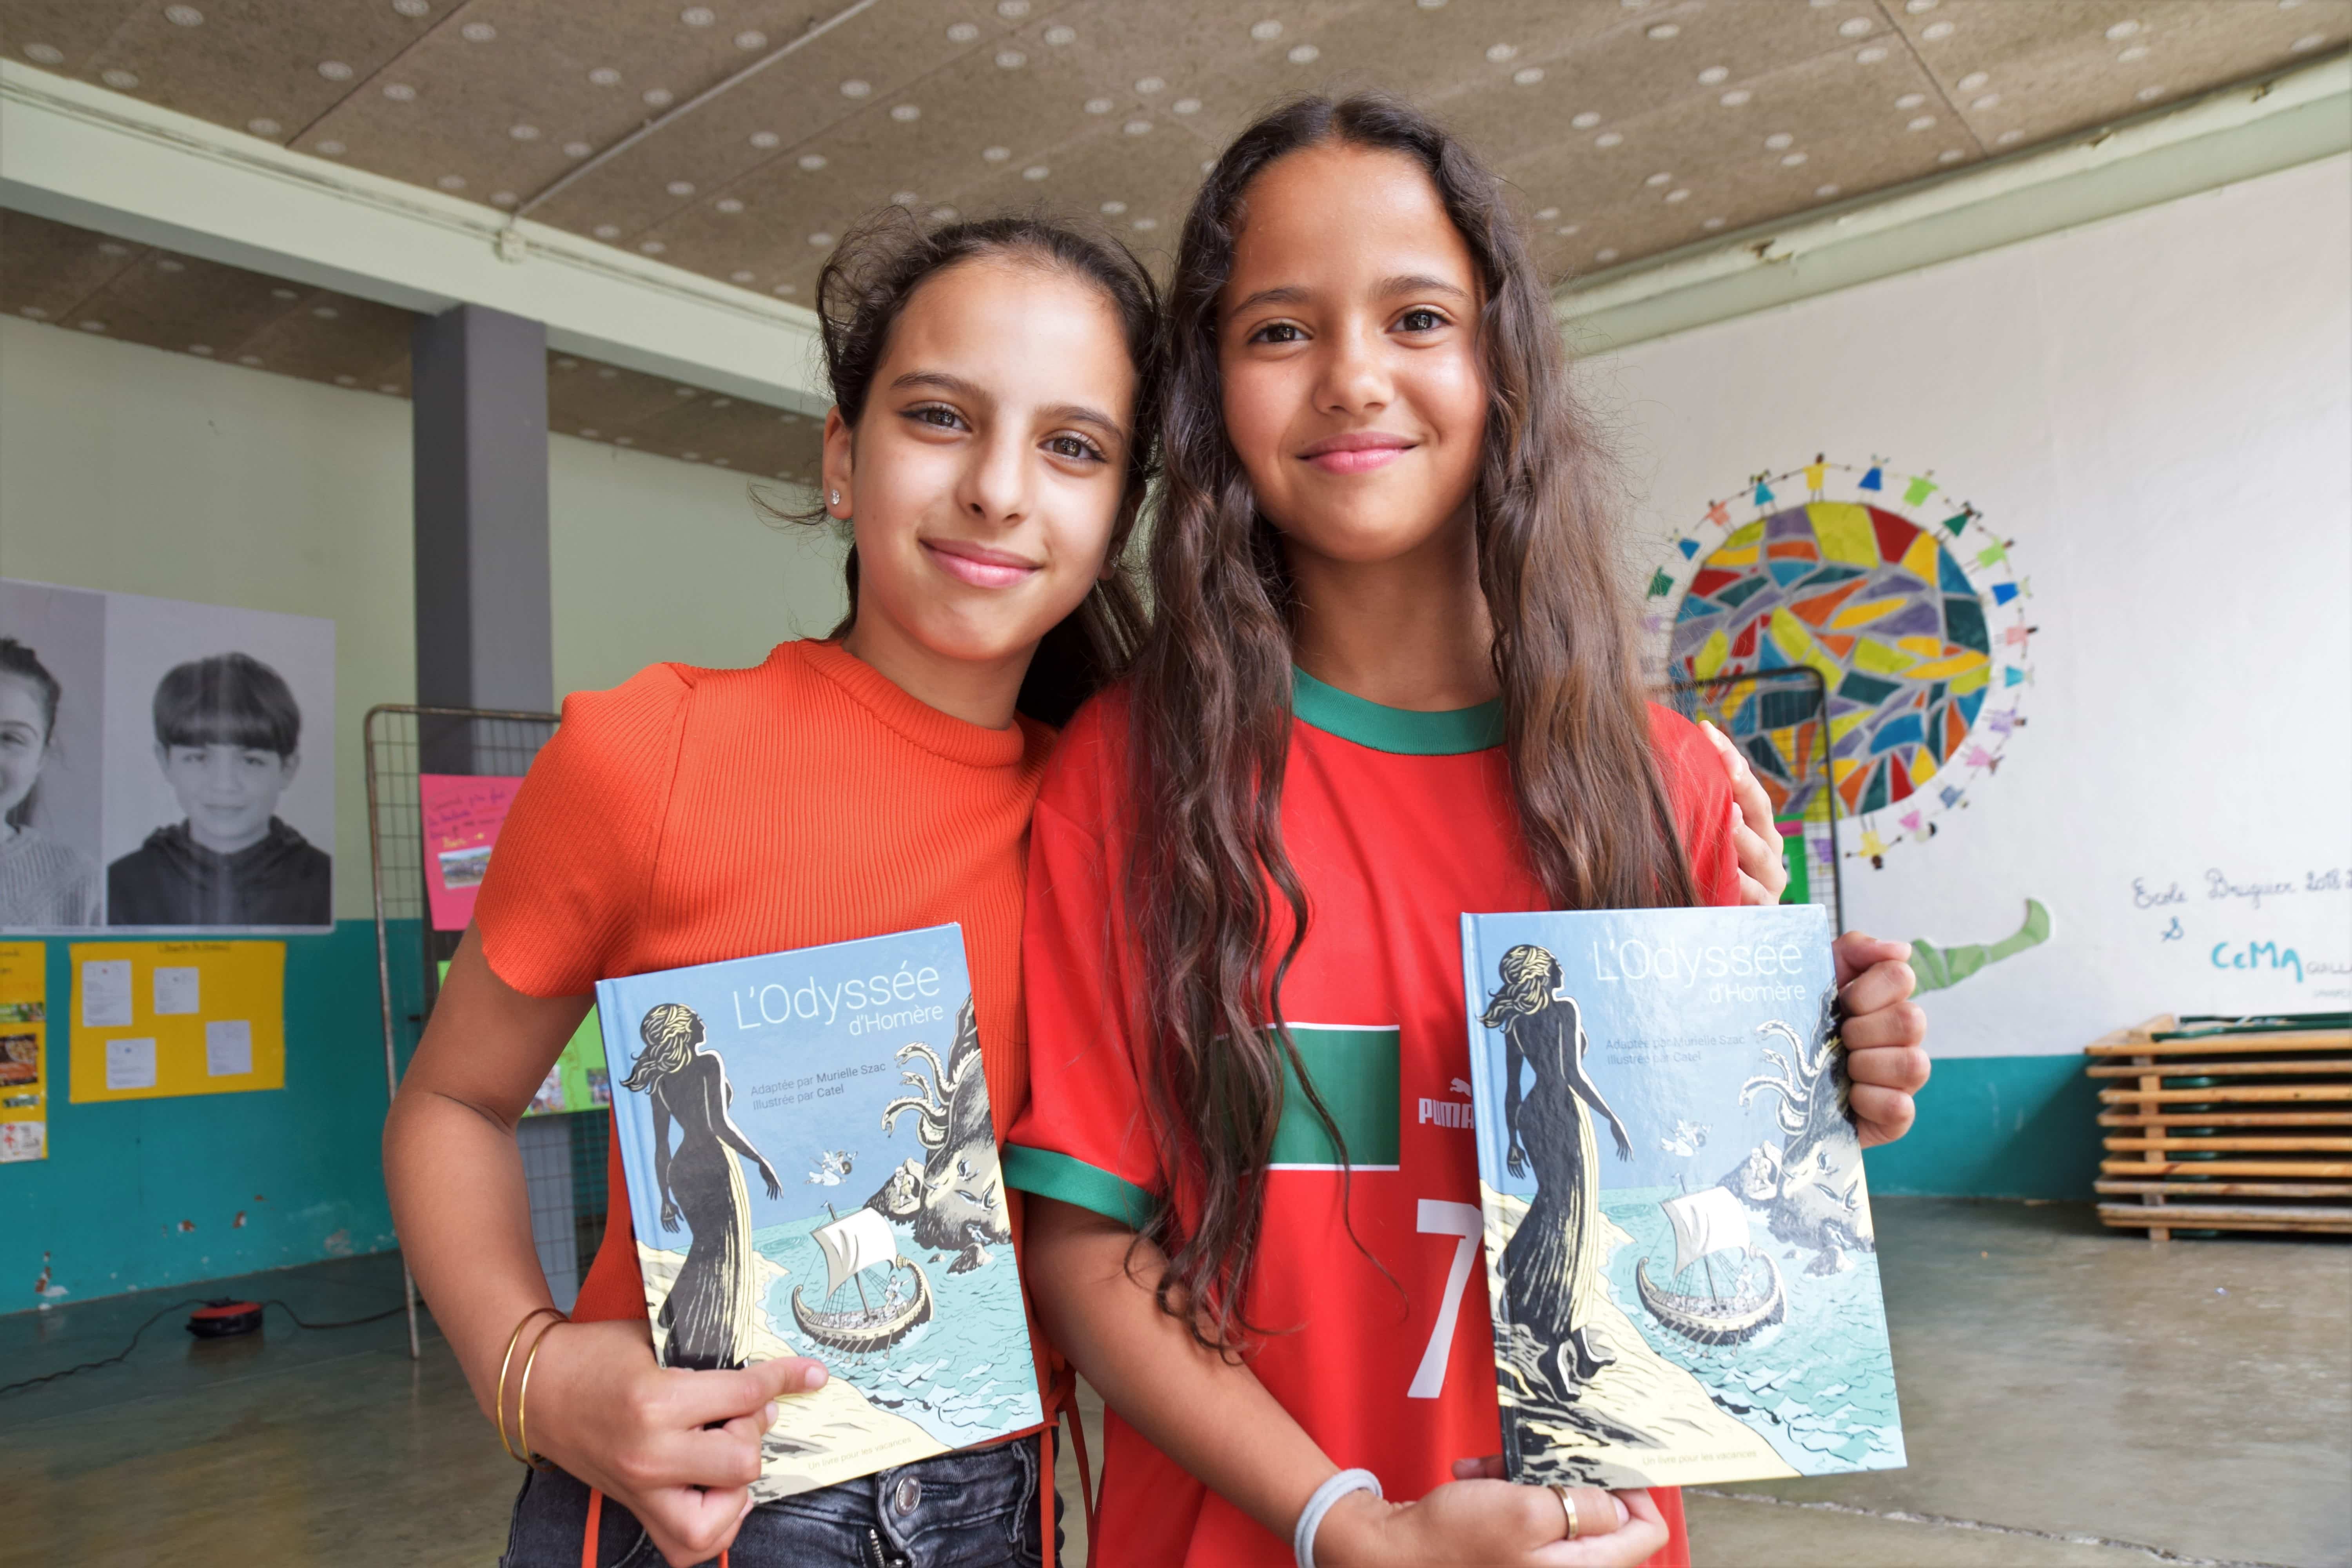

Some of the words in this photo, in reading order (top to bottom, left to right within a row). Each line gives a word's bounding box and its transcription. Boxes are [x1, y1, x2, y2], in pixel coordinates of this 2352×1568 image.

[1593, 935, 1802, 987] L'Odyssée
[733, 960, 940, 1029] L'Odyssée
[1709, 980, 1806, 1004] d'Homère
[849, 1005, 944, 1035] d'Homère
[1673, 1035, 1717, 1047] Murielle
[1719, 1034, 1745, 1045] Szac
[751, 1079, 794, 1096] Adaptée
[797, 1076, 813, 1089] par
[816, 1069, 858, 1083] Murielle
[860, 1062, 886, 1075] Szac
[753, 1095, 794, 1110] Illustrée
[797, 1091, 813, 1103] par
[817, 1084, 844, 1098] Catel
[1419, 1097, 1475, 1129] PUMA
[1407, 1198, 1484, 1399] 7
[808, 1462, 820, 1471] Un
[822, 1455, 839, 1466] livre
[840, 1451, 859, 1463] pour
[861, 1446, 873, 1456] les
[874, 1436, 912, 1452] vacances
